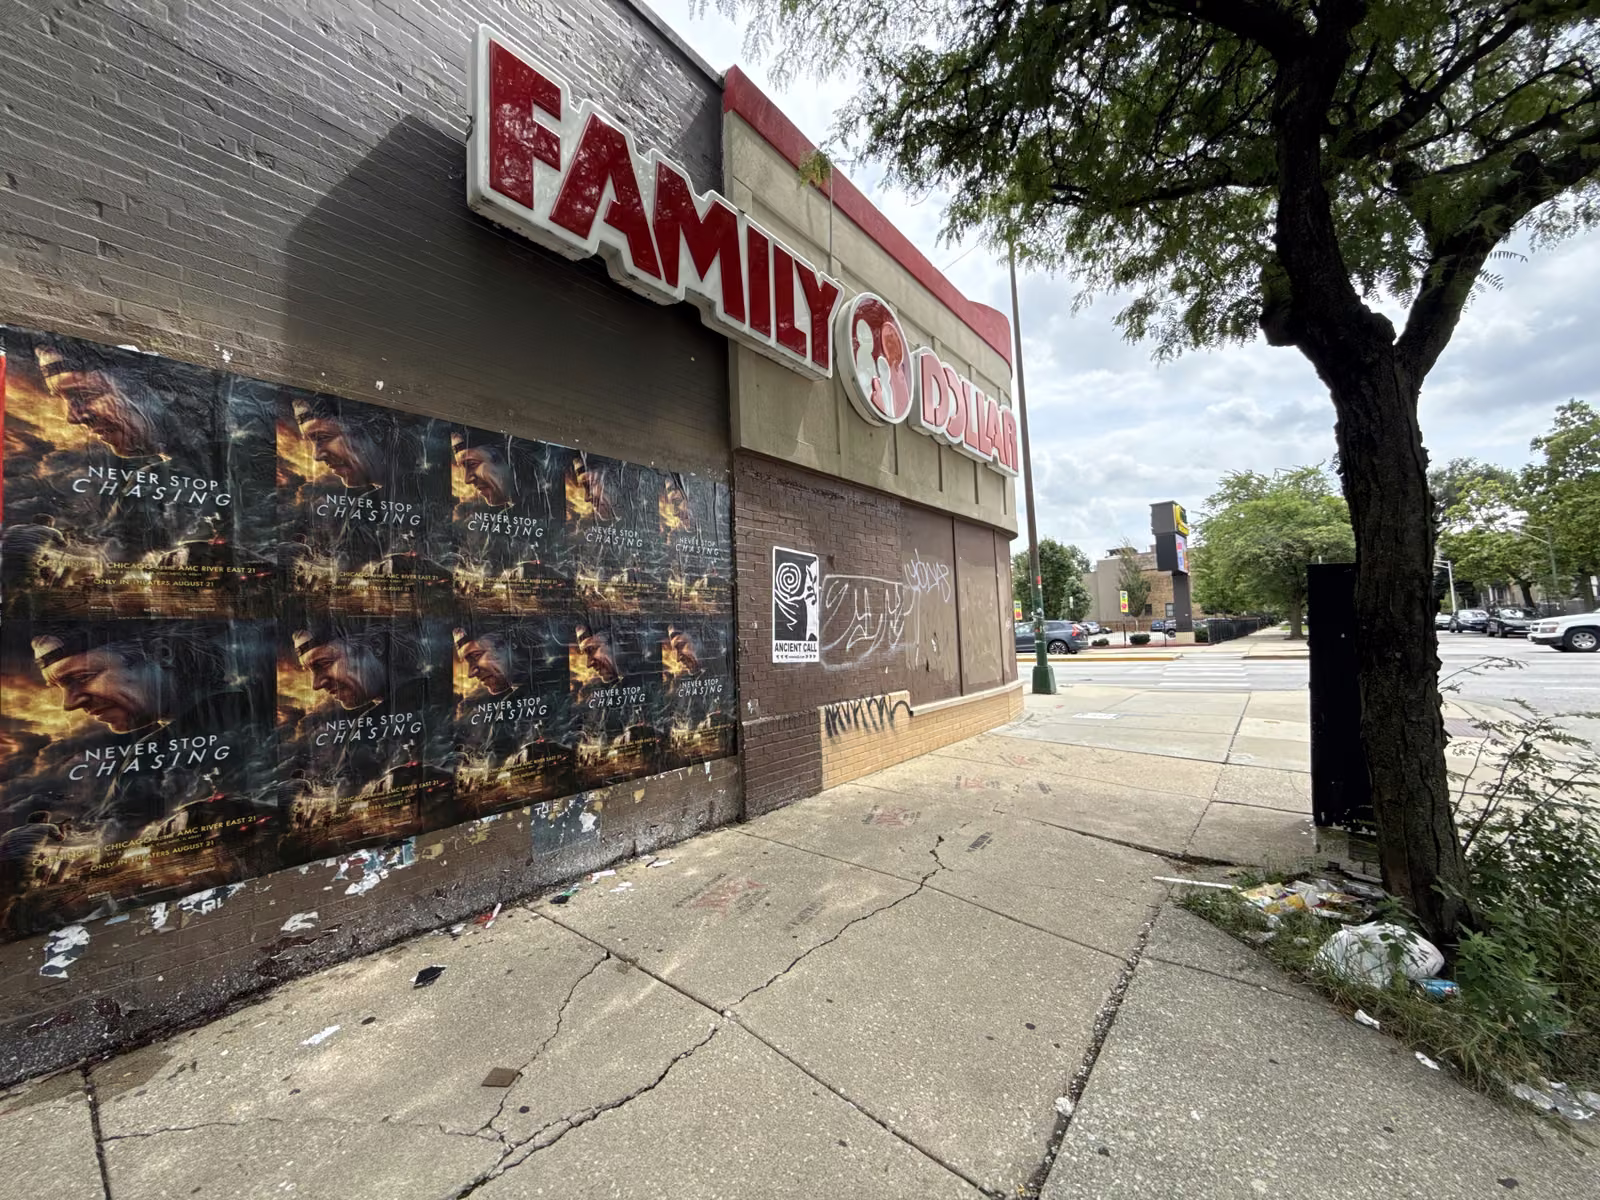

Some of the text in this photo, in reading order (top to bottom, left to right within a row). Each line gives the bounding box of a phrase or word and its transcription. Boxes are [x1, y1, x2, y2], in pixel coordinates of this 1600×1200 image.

[488, 39, 1018, 473] FAMILY DOLLAR
[88, 465, 218, 491] NEVER STOP
[72, 478, 231, 506] CHASING
[326, 494, 413, 512] NEVER STOP
[316, 504, 421, 526] CHASING
[474, 512, 537, 526] NEVER STOP
[468, 520, 544, 538] CHASING
[592, 526, 639, 539] NEVER STOP
[586, 533, 643, 548] CHASING
[108, 562, 152, 570] CHICAGO
[774, 642, 818, 652] ANCIENT CALL
[588, 693, 646, 709] CHASING
[594, 686, 641, 699] NEVER STOP
[471, 705, 548, 725] CHASING
[478, 697, 541, 713] NEVER STOP
[326, 712, 413, 732] NEVER STOP
[316, 722, 422, 747] CHASING
[85, 735, 218, 761] NEVER STOP
[68, 746, 231, 781] CHASING
[104, 837, 152, 852] CHICAGO
[177, 826, 199, 837] AMC
[201, 821, 224, 832] RIVER
[226, 818, 246, 827] EAST
[90, 862, 115, 872] ONLY
[132, 850, 170, 863] THEATERS
[172, 840, 204, 854] AUGUST
